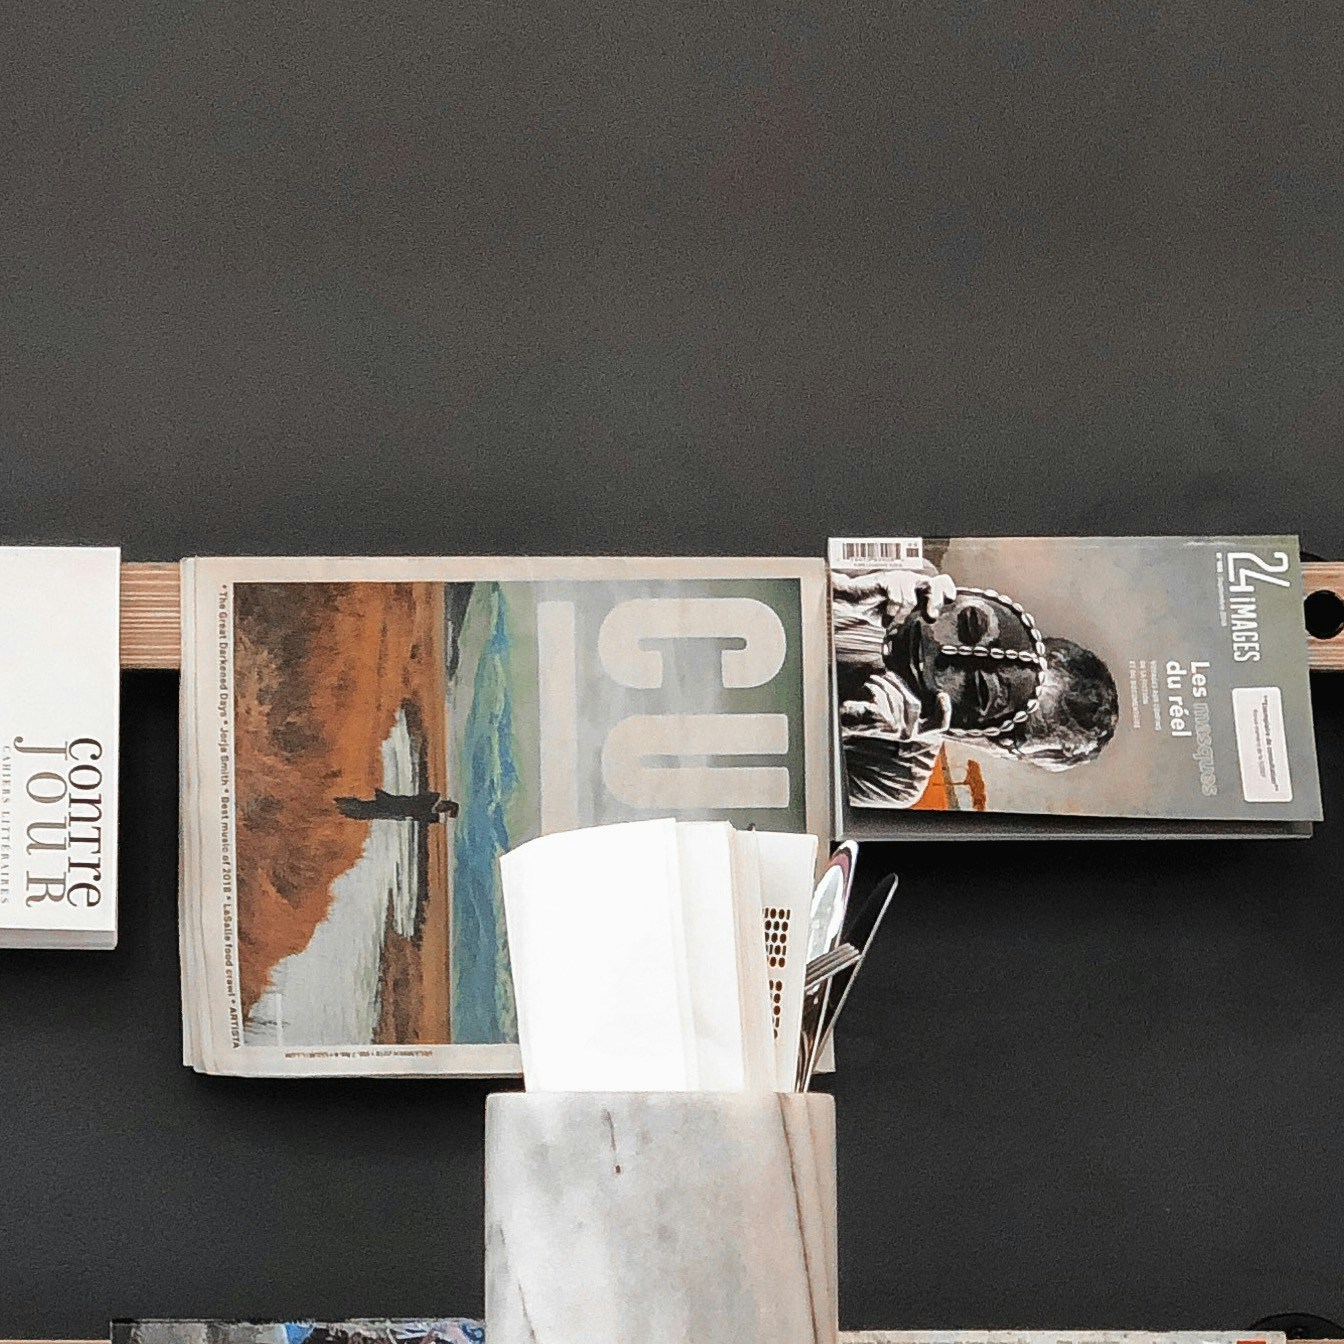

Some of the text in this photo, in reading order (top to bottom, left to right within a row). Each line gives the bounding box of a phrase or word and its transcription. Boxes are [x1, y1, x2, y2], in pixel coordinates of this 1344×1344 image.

[1227, 552, 1291, 592] 24
[218, 591, 228, 718] The Great Darkened Days
[1166, 661, 1192, 736] du réel
[218, 727, 230, 786] Jorja Smith
[1190, 661, 1217, 796] Les masques
[2, 746, 11, 804] CAHIERS
[220, 796, 229, 820] Best
[221, 822, 230, 853] music
[221, 855, 231, 867] of
[222, 904, 236, 997] LaSalle food crawl
[229, 1007, 241, 1049] ARTISTA
